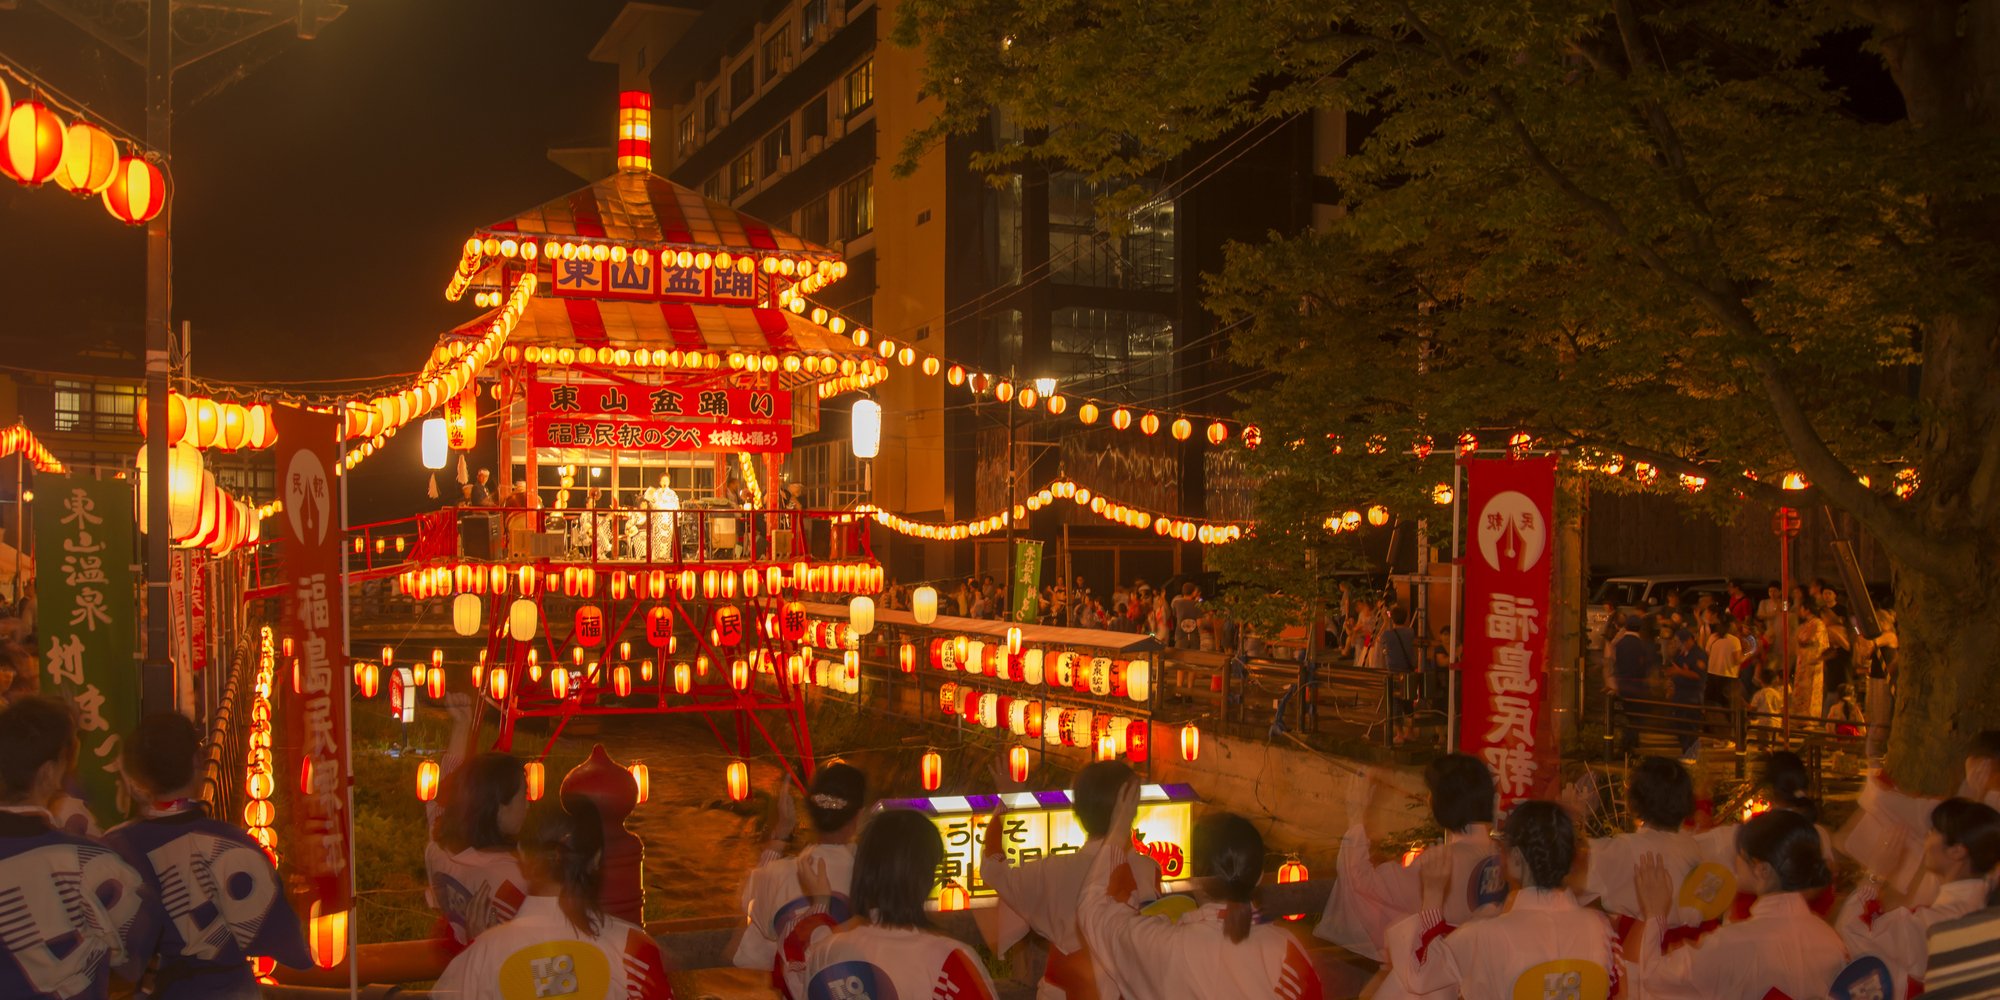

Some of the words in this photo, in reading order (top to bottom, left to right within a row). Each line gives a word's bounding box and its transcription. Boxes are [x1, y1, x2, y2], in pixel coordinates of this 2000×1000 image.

[557, 252, 754, 297] 東山盆踊
[548, 422, 702, 448] 福島民報の夕べ
[581, 615, 600, 638] 福
[653, 615, 671, 638] 島
[721, 614, 741, 636] 民
[785, 610, 805, 632] 報
